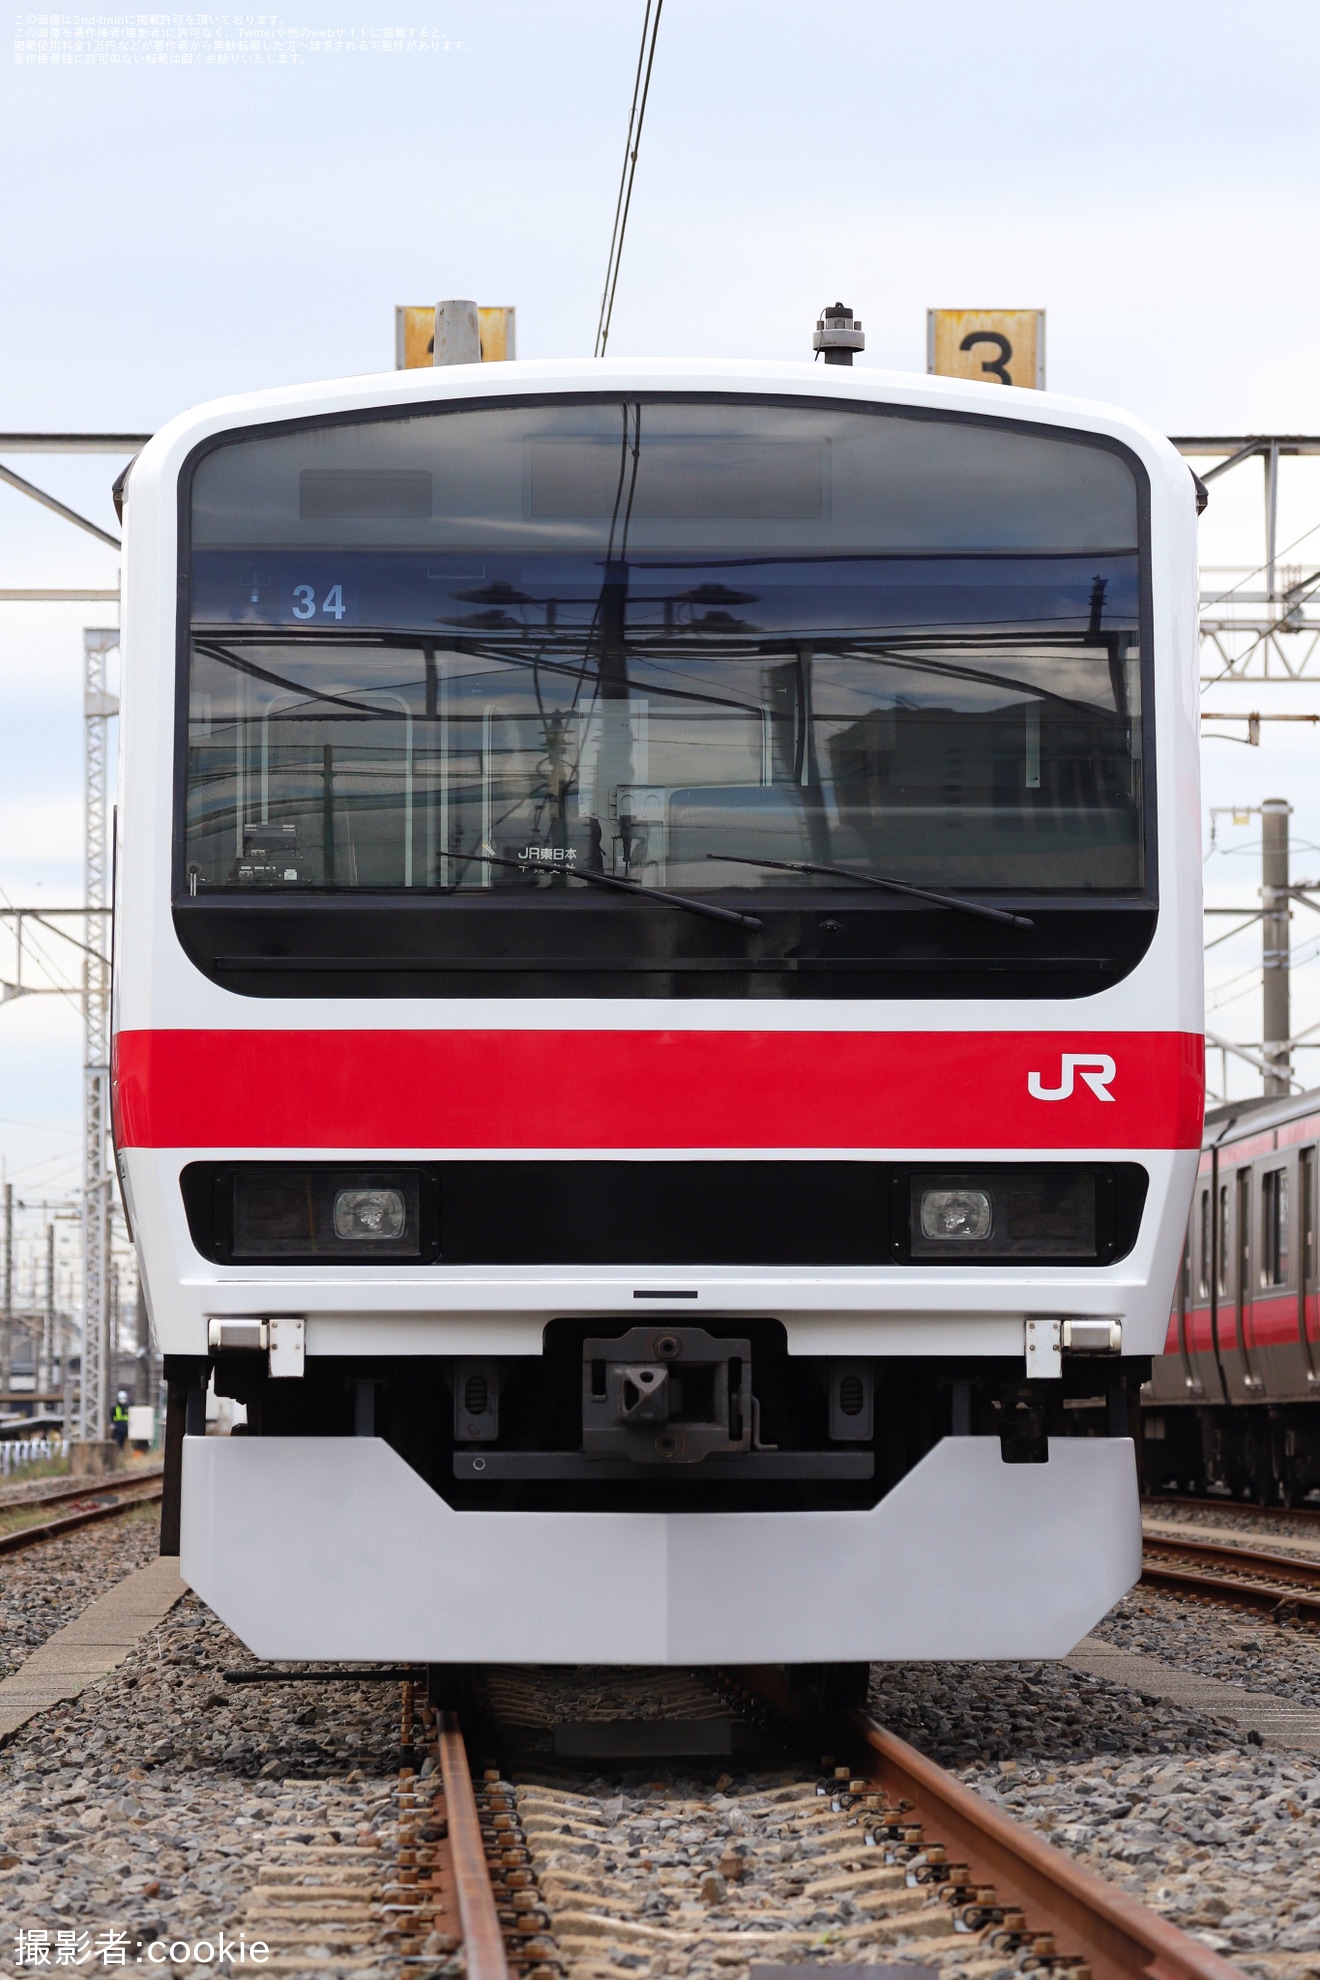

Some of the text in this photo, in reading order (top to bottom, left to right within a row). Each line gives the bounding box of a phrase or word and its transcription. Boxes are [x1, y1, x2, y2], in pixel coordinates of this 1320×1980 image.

[959, 331, 1013, 386] 3
[292, 584, 346, 620] 34
[518, 847, 577, 860] JR東日本
[1027, 1053, 1117, 1102] JR
